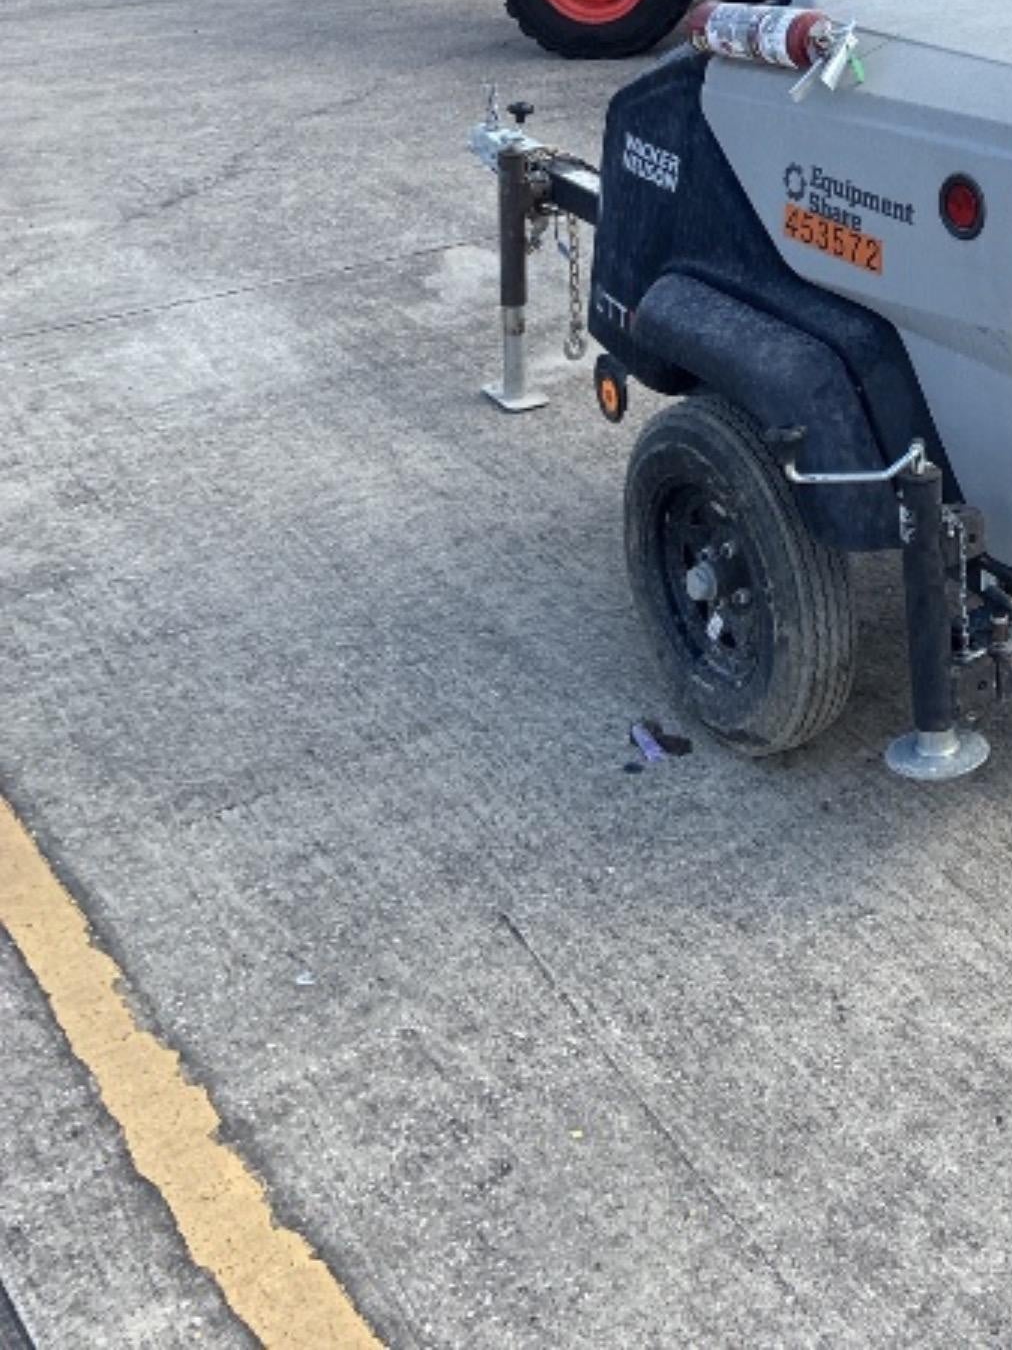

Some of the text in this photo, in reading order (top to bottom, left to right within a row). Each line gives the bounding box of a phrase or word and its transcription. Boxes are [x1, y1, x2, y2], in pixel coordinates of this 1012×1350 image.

[809, 191, 862, 232] Share
[810, 164, 916, 226] Equipment
[785, 209, 880, 271] 453572
